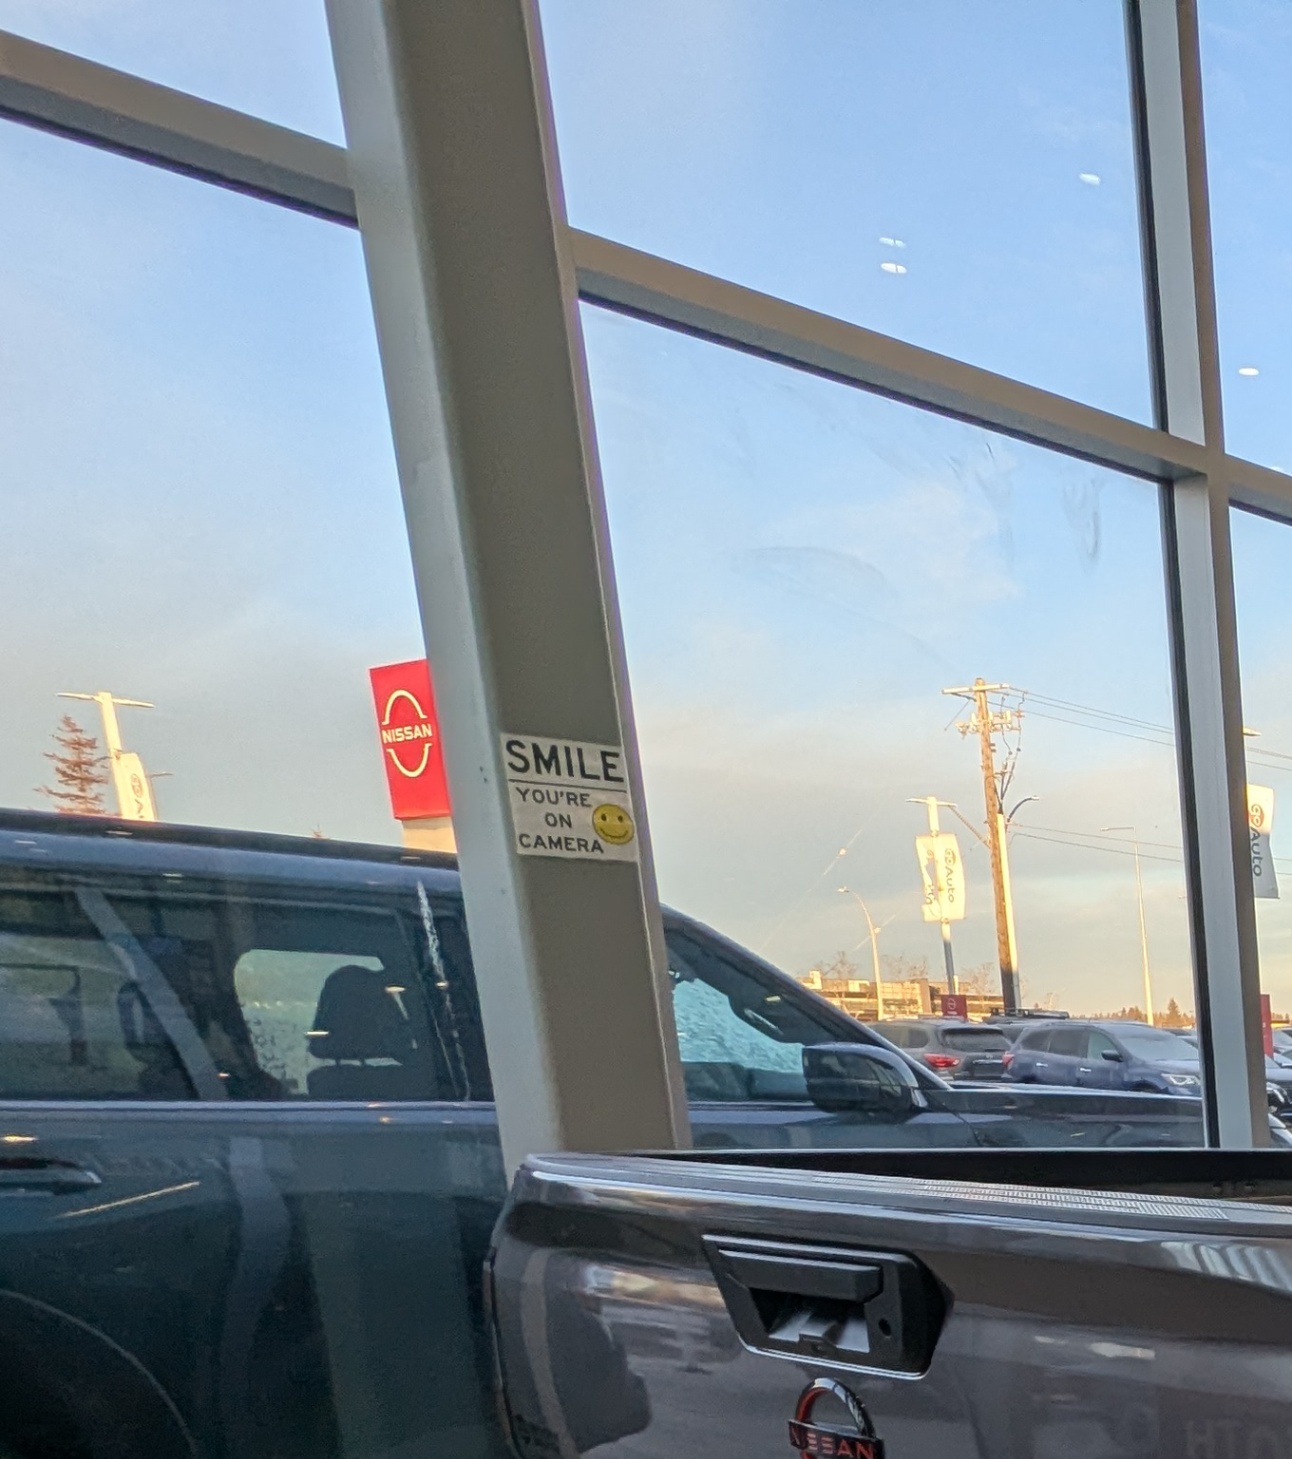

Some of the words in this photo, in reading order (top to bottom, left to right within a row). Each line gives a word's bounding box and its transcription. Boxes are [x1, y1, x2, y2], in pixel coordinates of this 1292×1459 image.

[381, 723, 433, 744] NISSAN
[505, 739, 625, 783] SMILE
[516, 786, 593, 808] YOU'RE
[544, 812, 573, 829] ON
[518, 833, 605, 854] CAMERA
